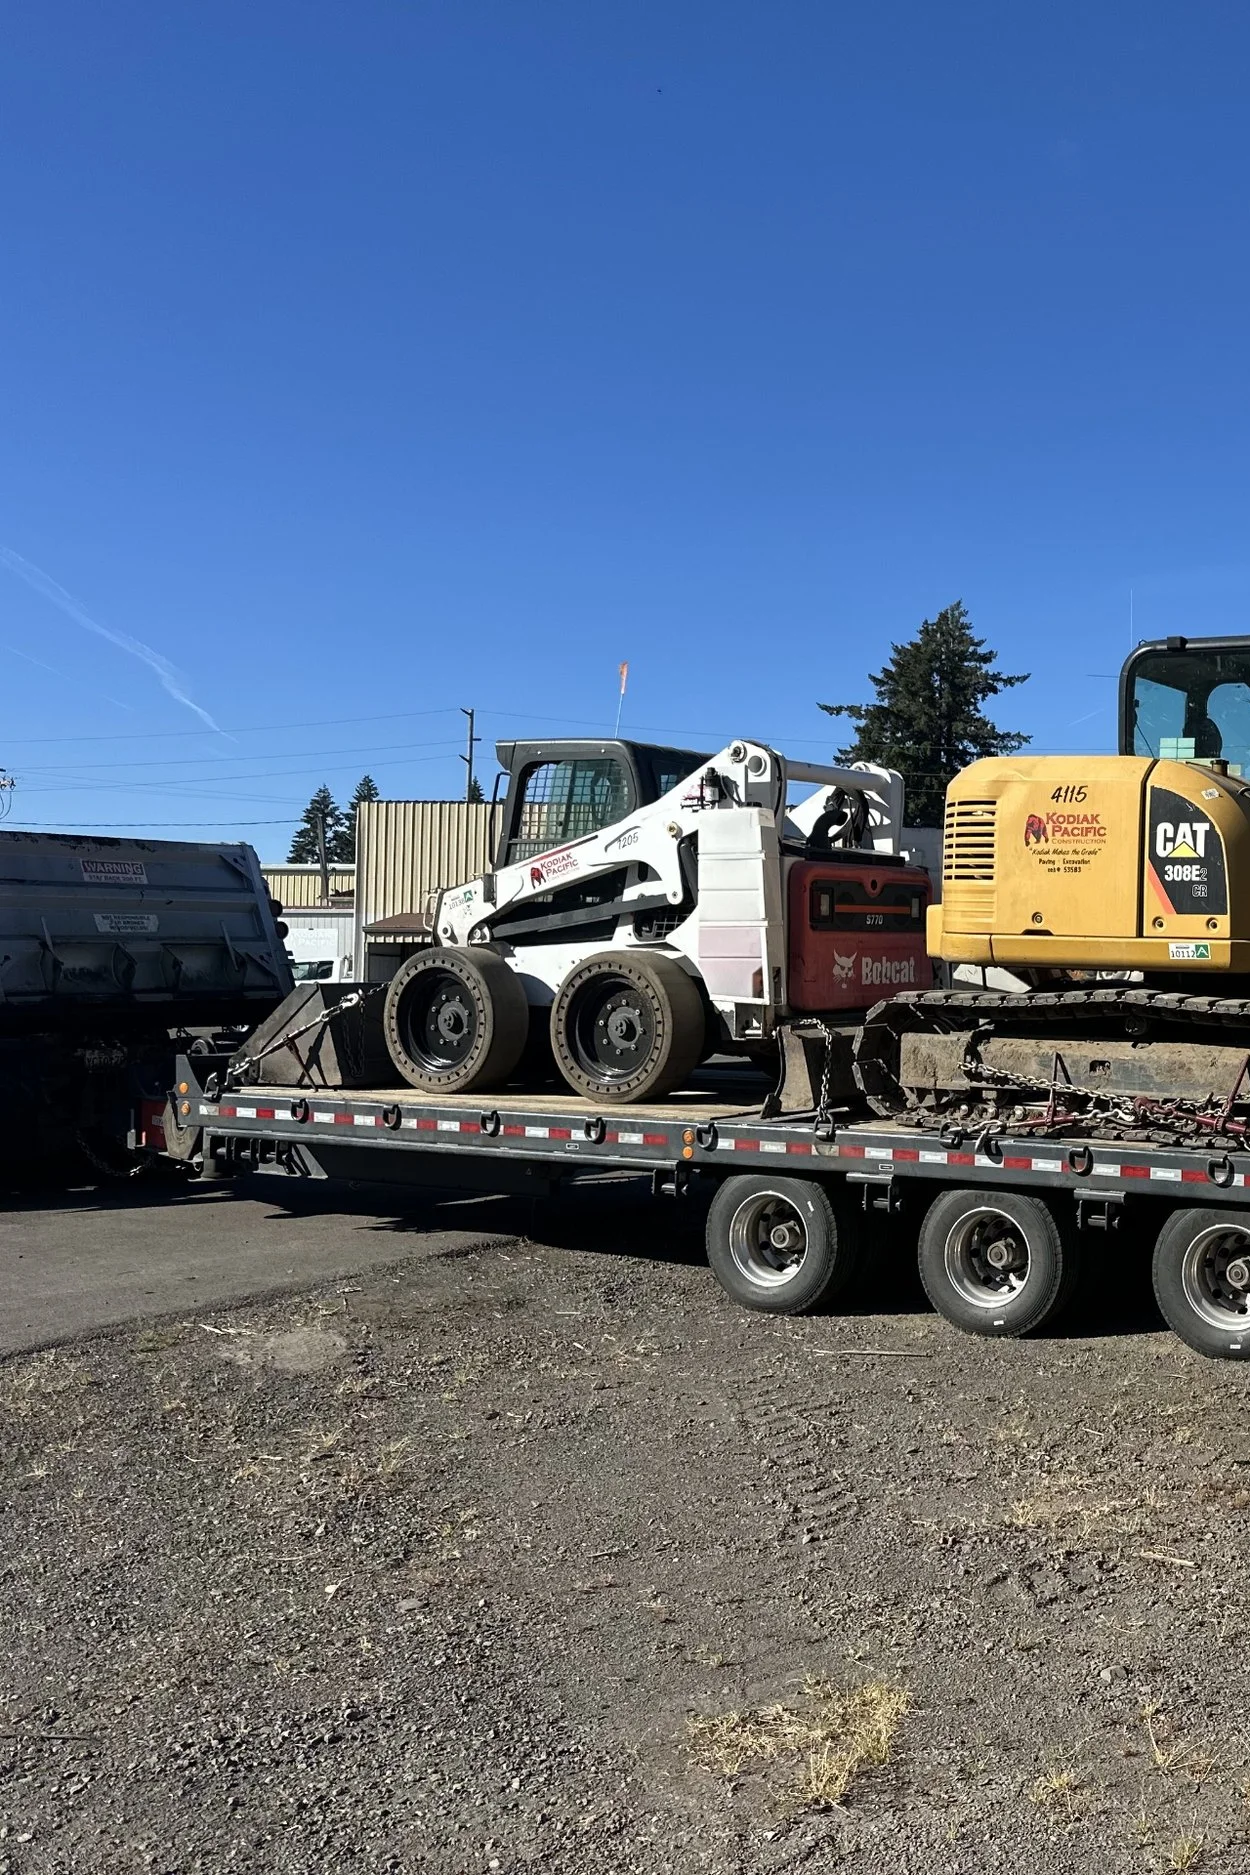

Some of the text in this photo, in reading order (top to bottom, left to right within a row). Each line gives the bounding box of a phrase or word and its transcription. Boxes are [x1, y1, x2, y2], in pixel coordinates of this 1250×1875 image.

[1051, 785, 1088, 803] 4115
[1046, 812, 1100, 825] KODIAK
[1051, 825, 1107, 837] PACIFIC
[1156, 822, 1210, 858] CAT
[84, 862, 142, 874] WARNING
[540, 852, 573, 871] KODIAK
[545, 859, 579, 877] PACIFIC
[1191, 884, 1208, 897] CR
[866, 915, 883, 925] S770
[861, 956, 915, 985] Bobcat
